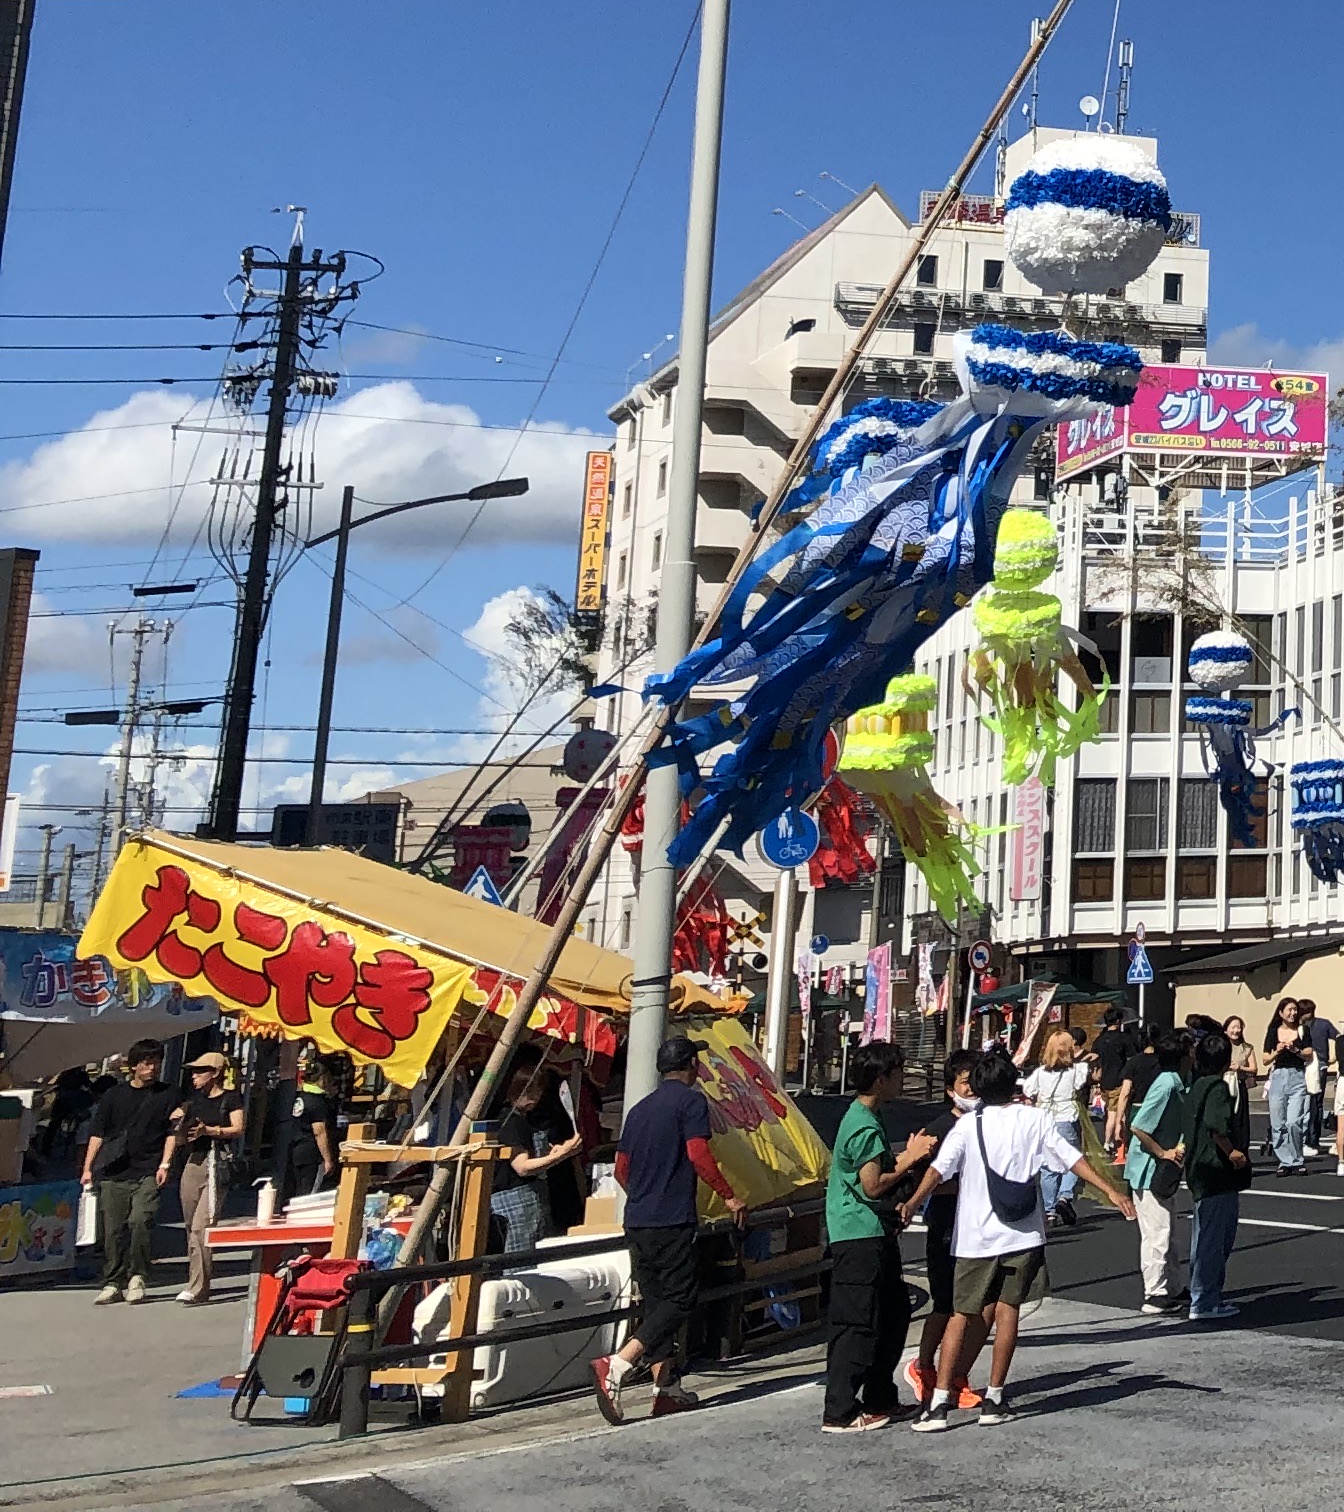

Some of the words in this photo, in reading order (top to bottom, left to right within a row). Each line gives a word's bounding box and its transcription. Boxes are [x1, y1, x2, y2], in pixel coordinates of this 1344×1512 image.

[1198, 373, 1262, 390] HOTEL
[1158, 389, 1299, 437] グレイス
[116, 865, 434, 1059] たこやき
